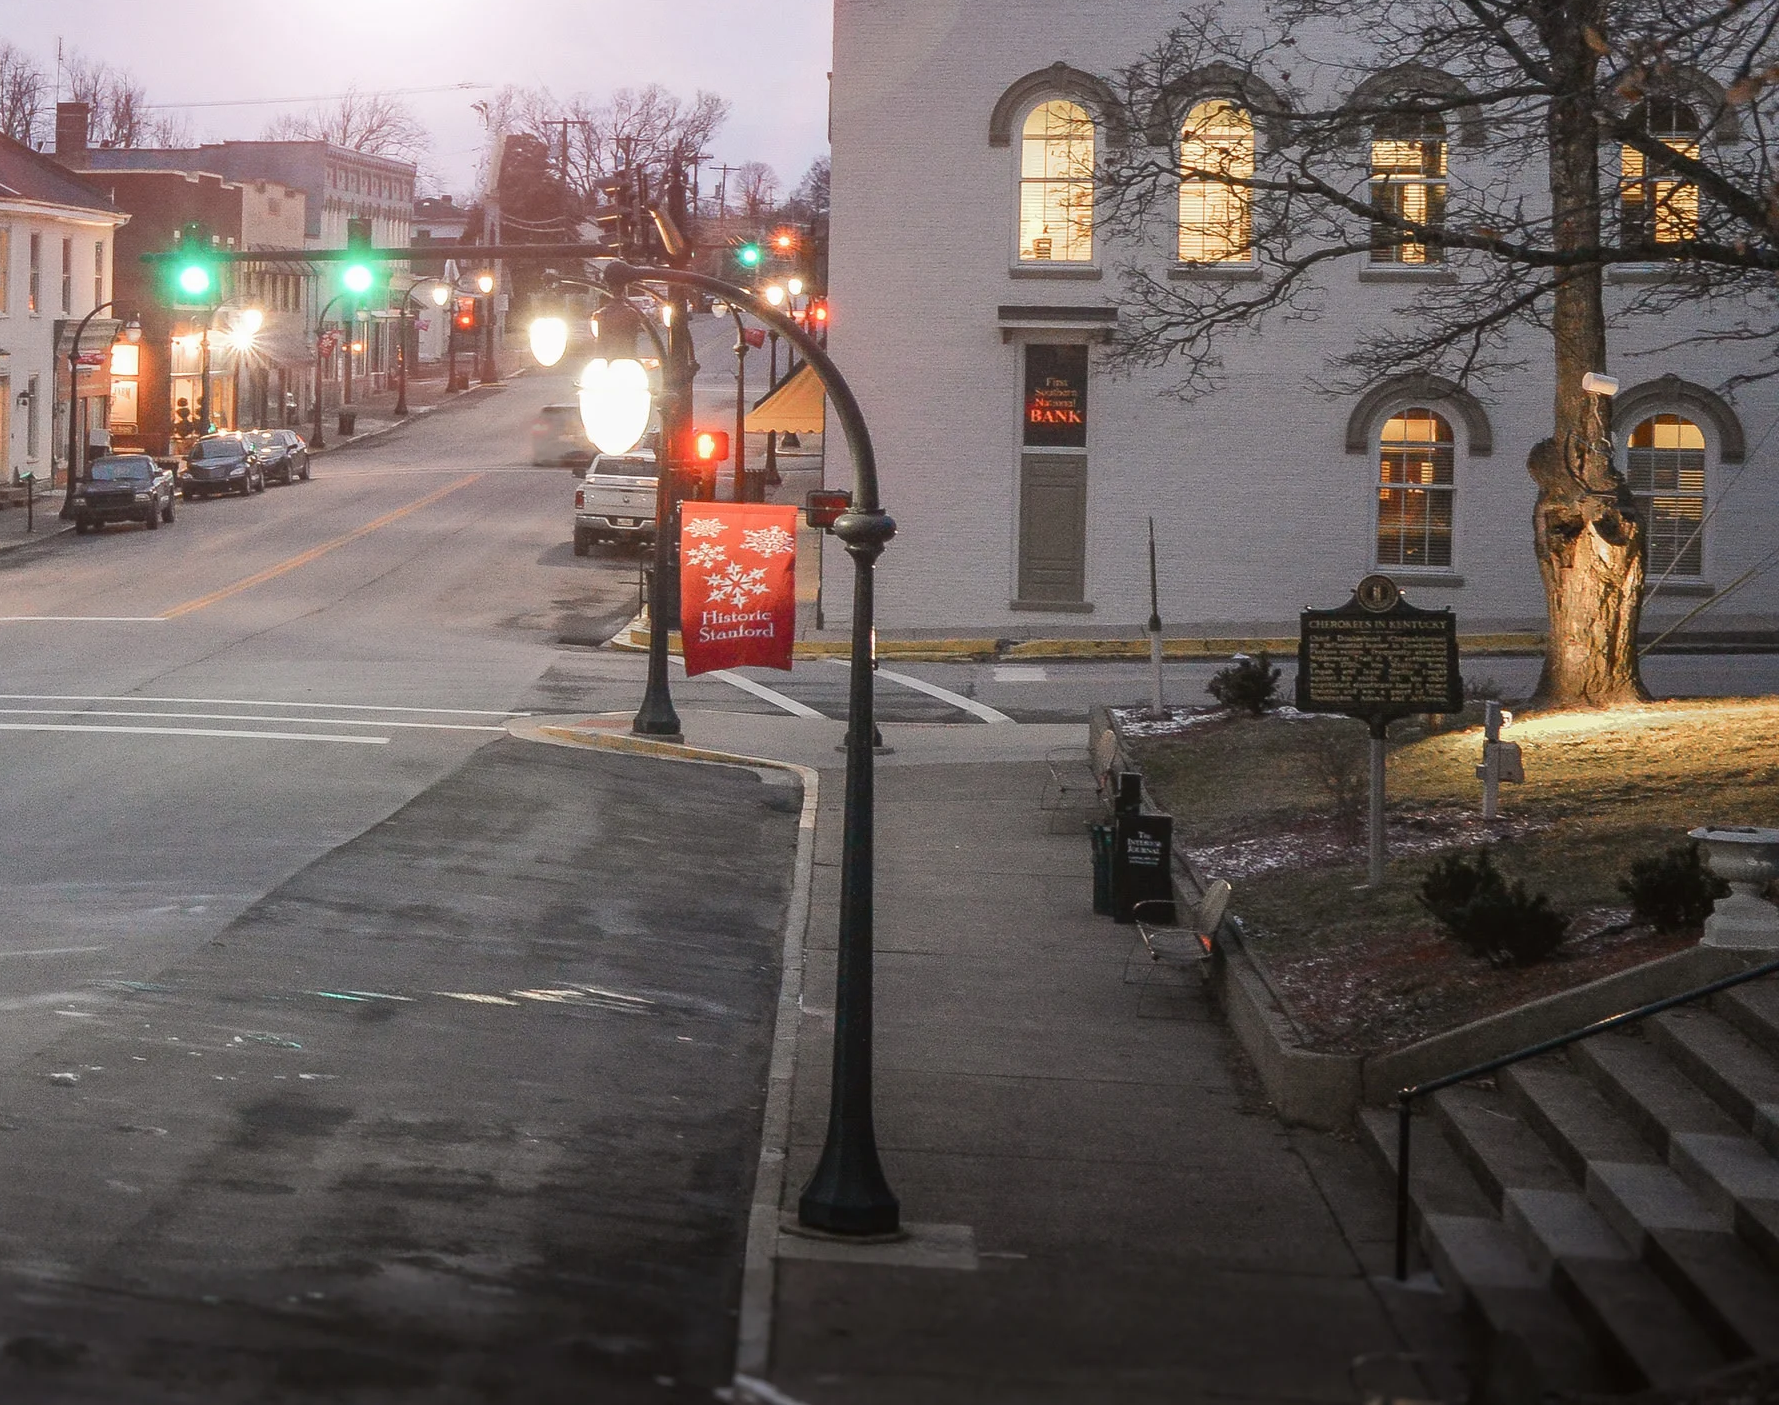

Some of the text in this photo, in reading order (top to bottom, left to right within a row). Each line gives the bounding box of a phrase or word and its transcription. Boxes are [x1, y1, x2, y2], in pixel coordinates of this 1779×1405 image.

[1046, 377, 1068, 387] First
[1030, 409, 1083, 424] BANK
[702, 609, 772, 626] Historic
[1308, 620, 1447, 629] CHEROKEES IN KENTUCKY
[699, 622, 775, 643] Stanford
